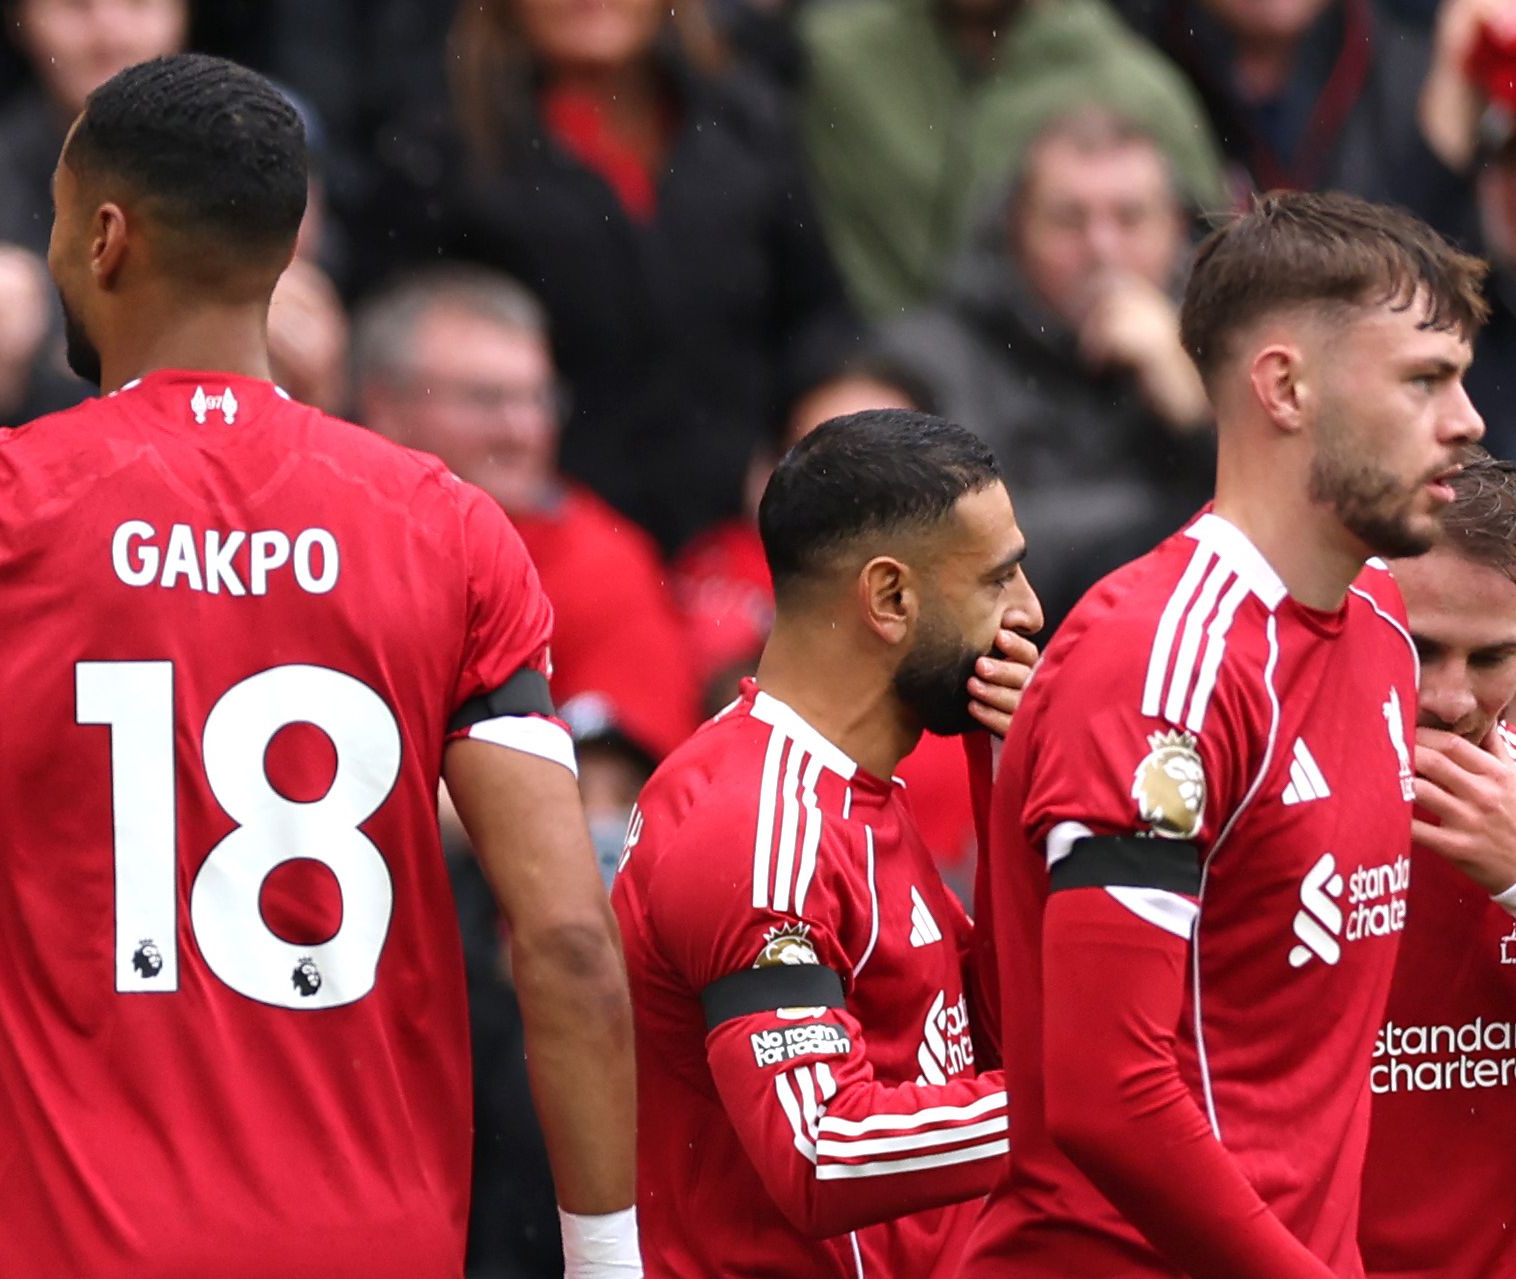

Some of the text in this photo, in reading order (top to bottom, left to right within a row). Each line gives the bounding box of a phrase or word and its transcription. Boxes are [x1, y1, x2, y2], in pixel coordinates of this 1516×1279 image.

[112, 520, 340, 596] GAKPO
[74, 660, 403, 1011] 18
[750, 1024, 839, 1051] No room
[754, 1046, 785, 1068] for
[1372, 1016, 1516, 1058] standa
[1370, 1055, 1516, 1094] charter
